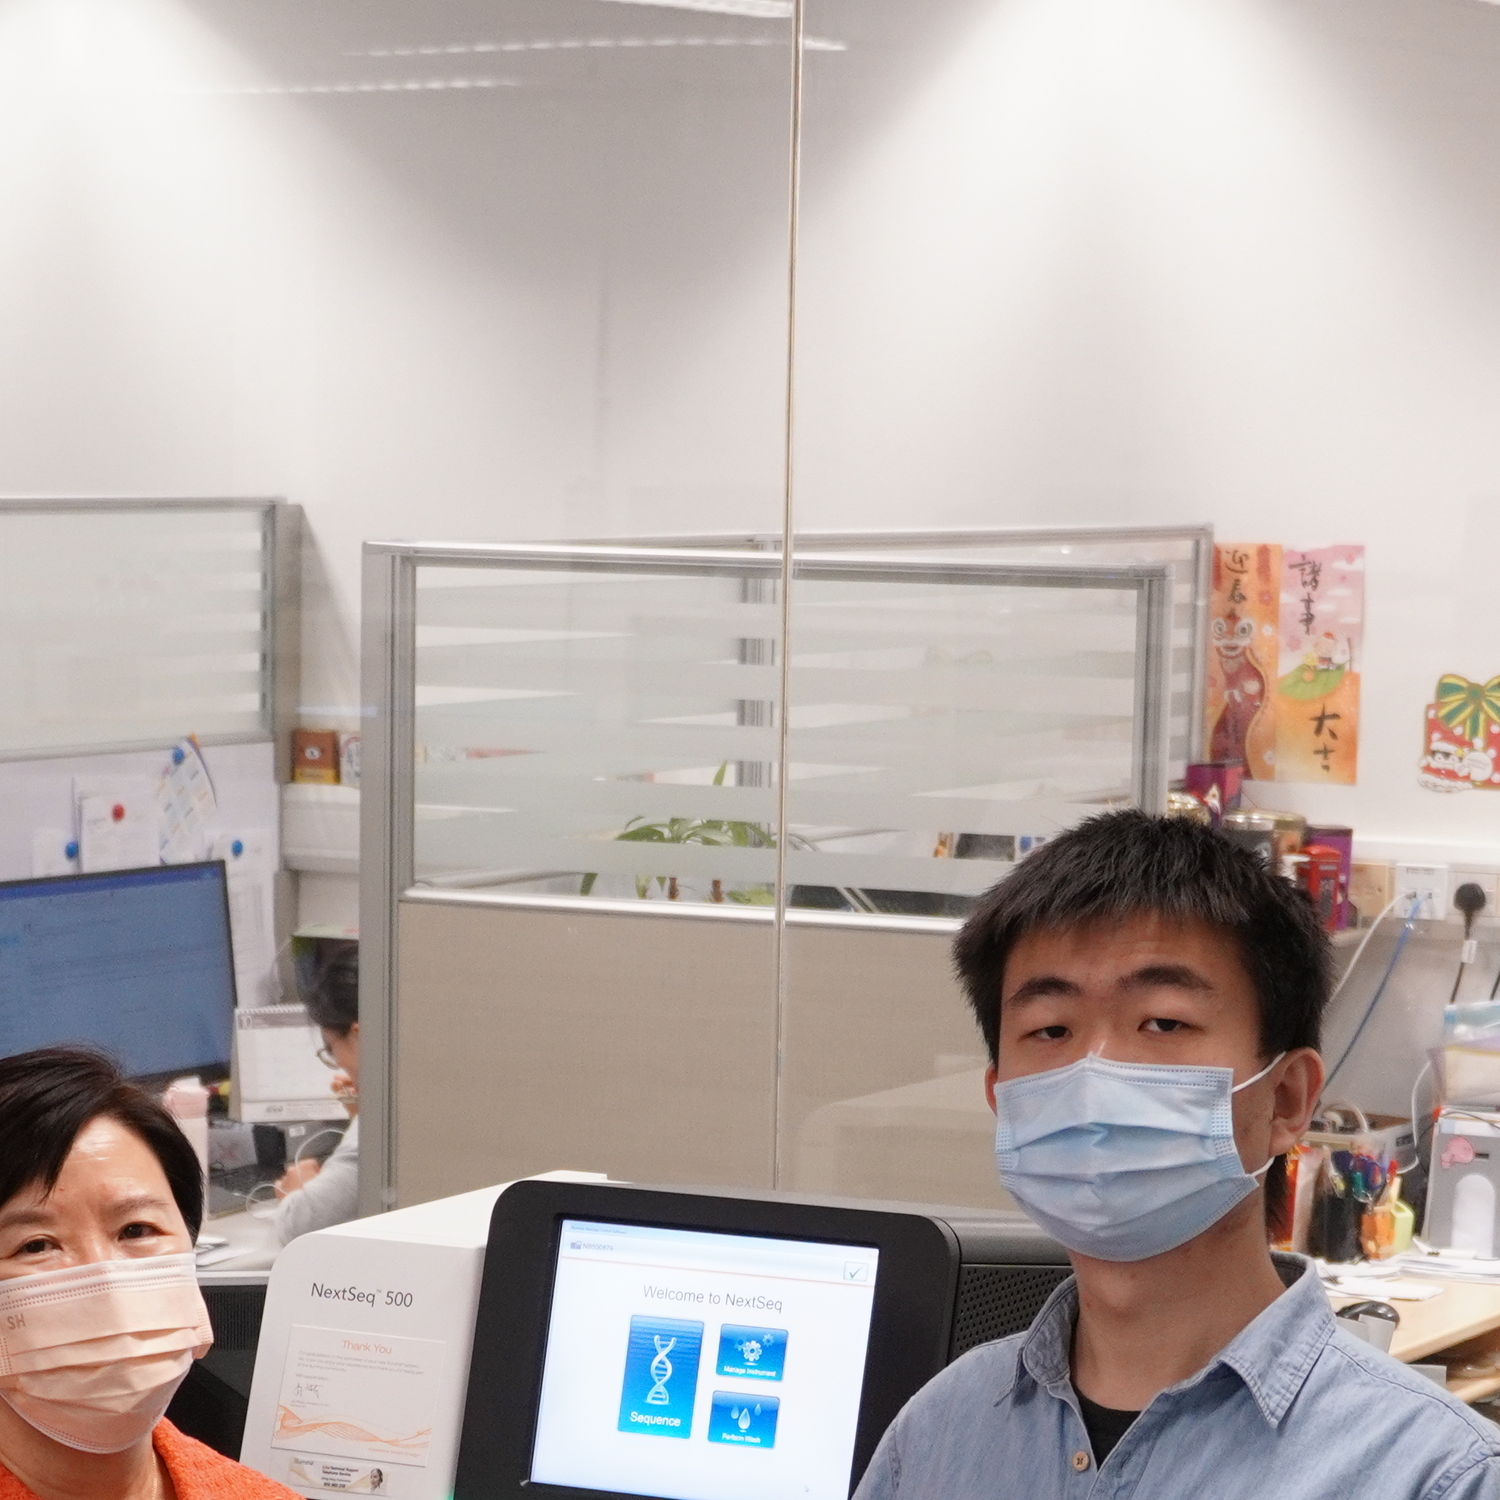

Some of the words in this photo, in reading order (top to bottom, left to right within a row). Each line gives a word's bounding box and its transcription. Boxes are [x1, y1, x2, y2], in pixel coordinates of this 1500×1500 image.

[1225, 550, 1250, 604] 迎春
[385, 1291, 413, 1307] 500
[643, 1285, 704, 1303] Welcome
[708, 1294, 721, 1305] to
[725, 1294, 783, 1314] NextSeq
[342, 1340, 371, 1352] Thank
[373, 1344, 393, 1355] You
[724, 1366, 746, 1375] Manage
[746, 1368, 776, 1377] Instrument
[630, 1411, 682, 1427] Sequence
